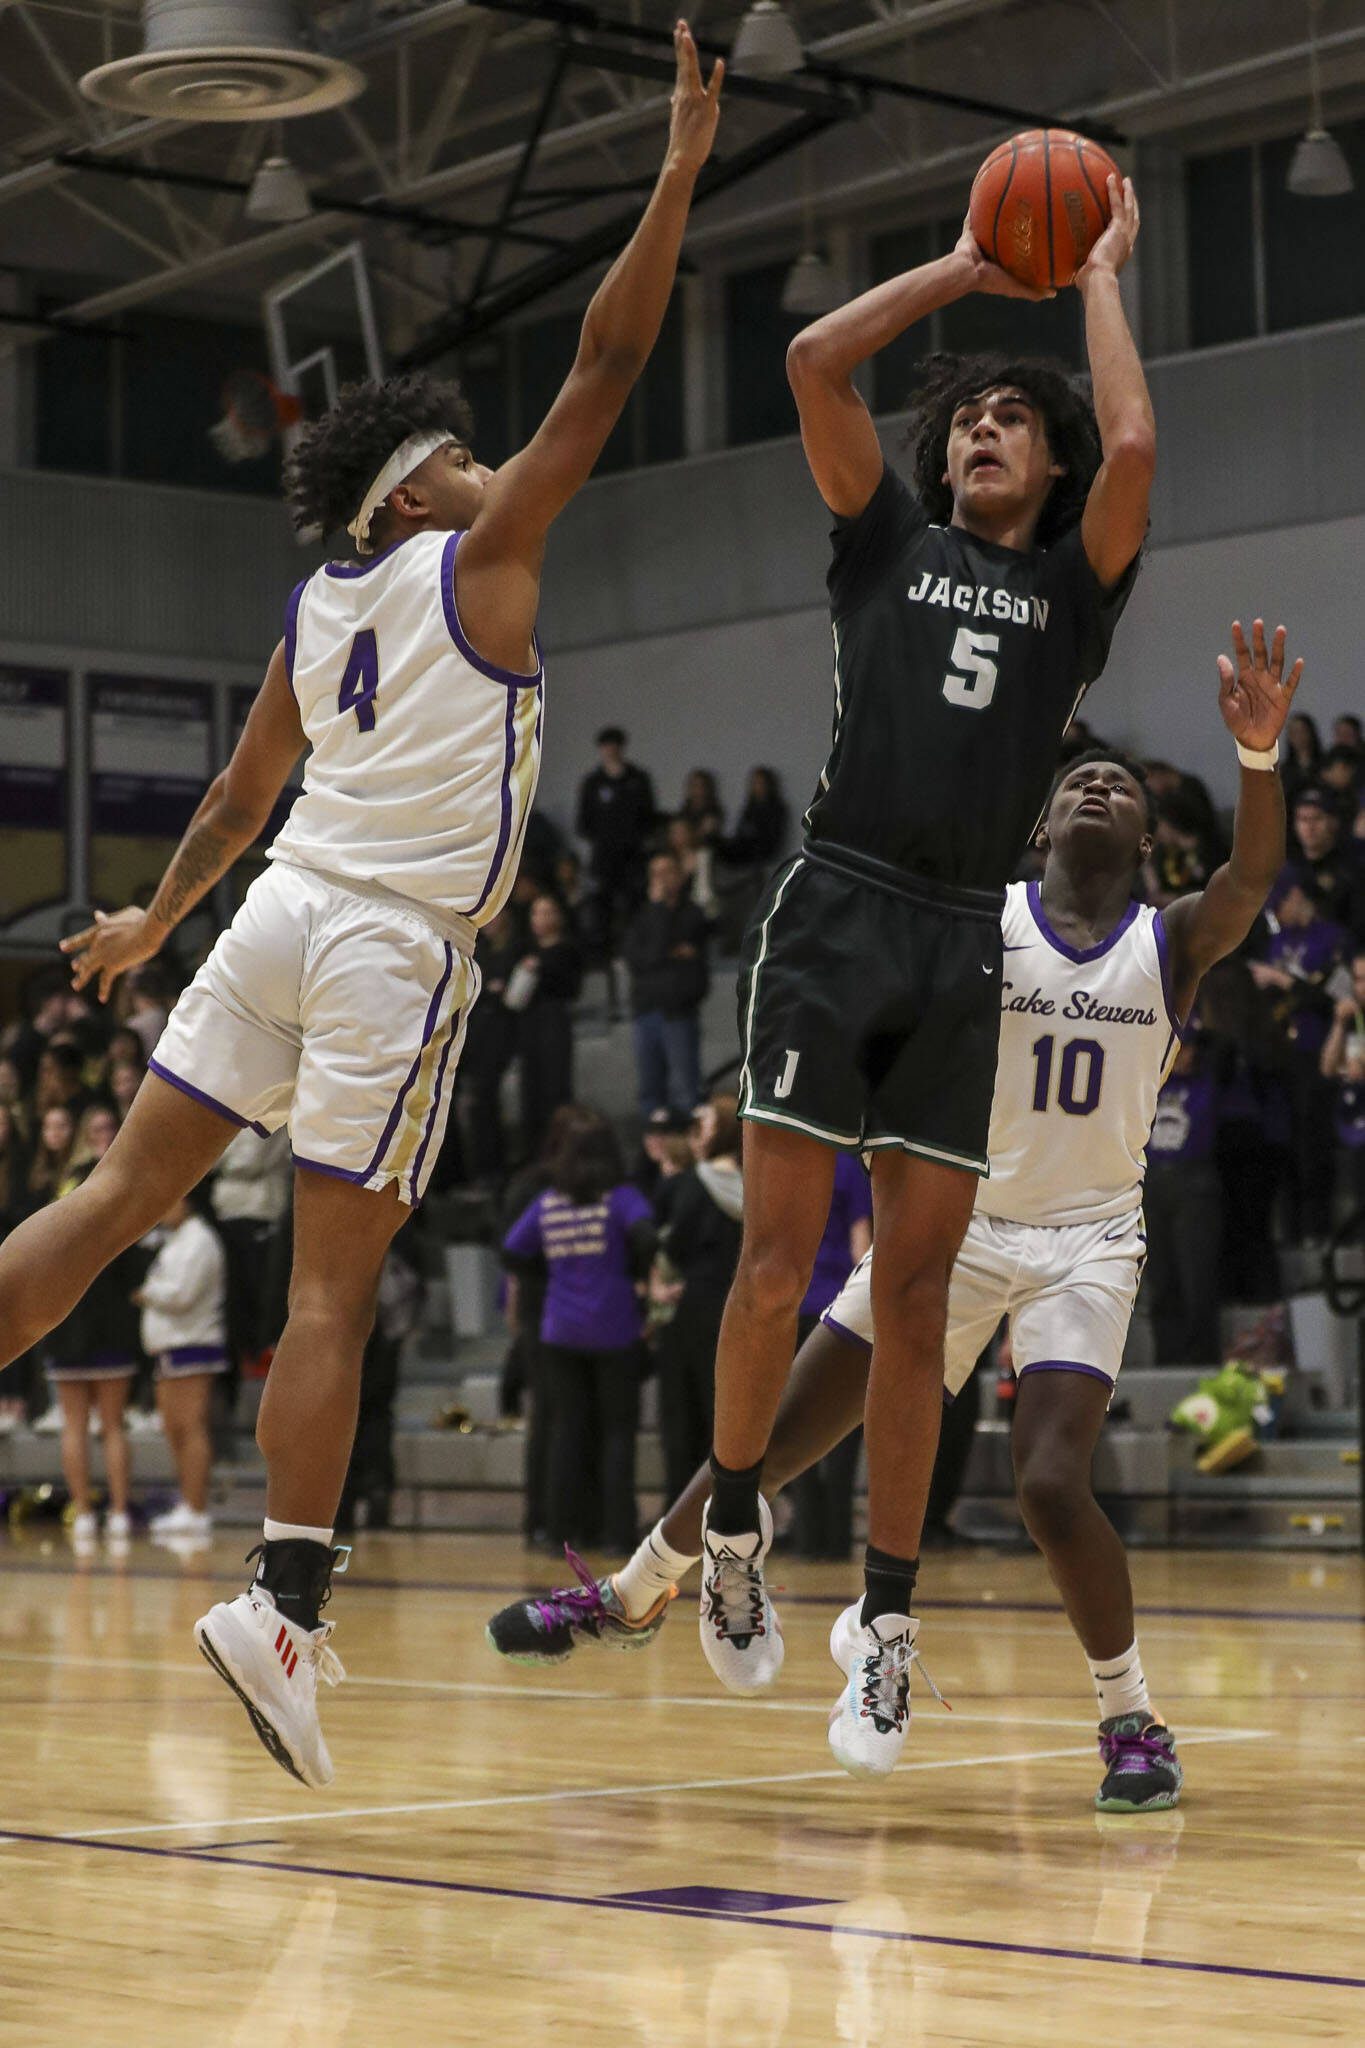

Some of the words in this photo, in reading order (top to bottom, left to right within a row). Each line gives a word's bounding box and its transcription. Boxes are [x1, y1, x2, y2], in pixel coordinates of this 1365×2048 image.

[908, 572, 1050, 632] JACKSON
[338, 627, 380, 735] 4
[943, 628, 1000, 710] 5
[1063, 990, 1158, 1026] Stevens
[774, 1049, 801, 1099] J
[1032, 1034, 1105, 1117] 10
